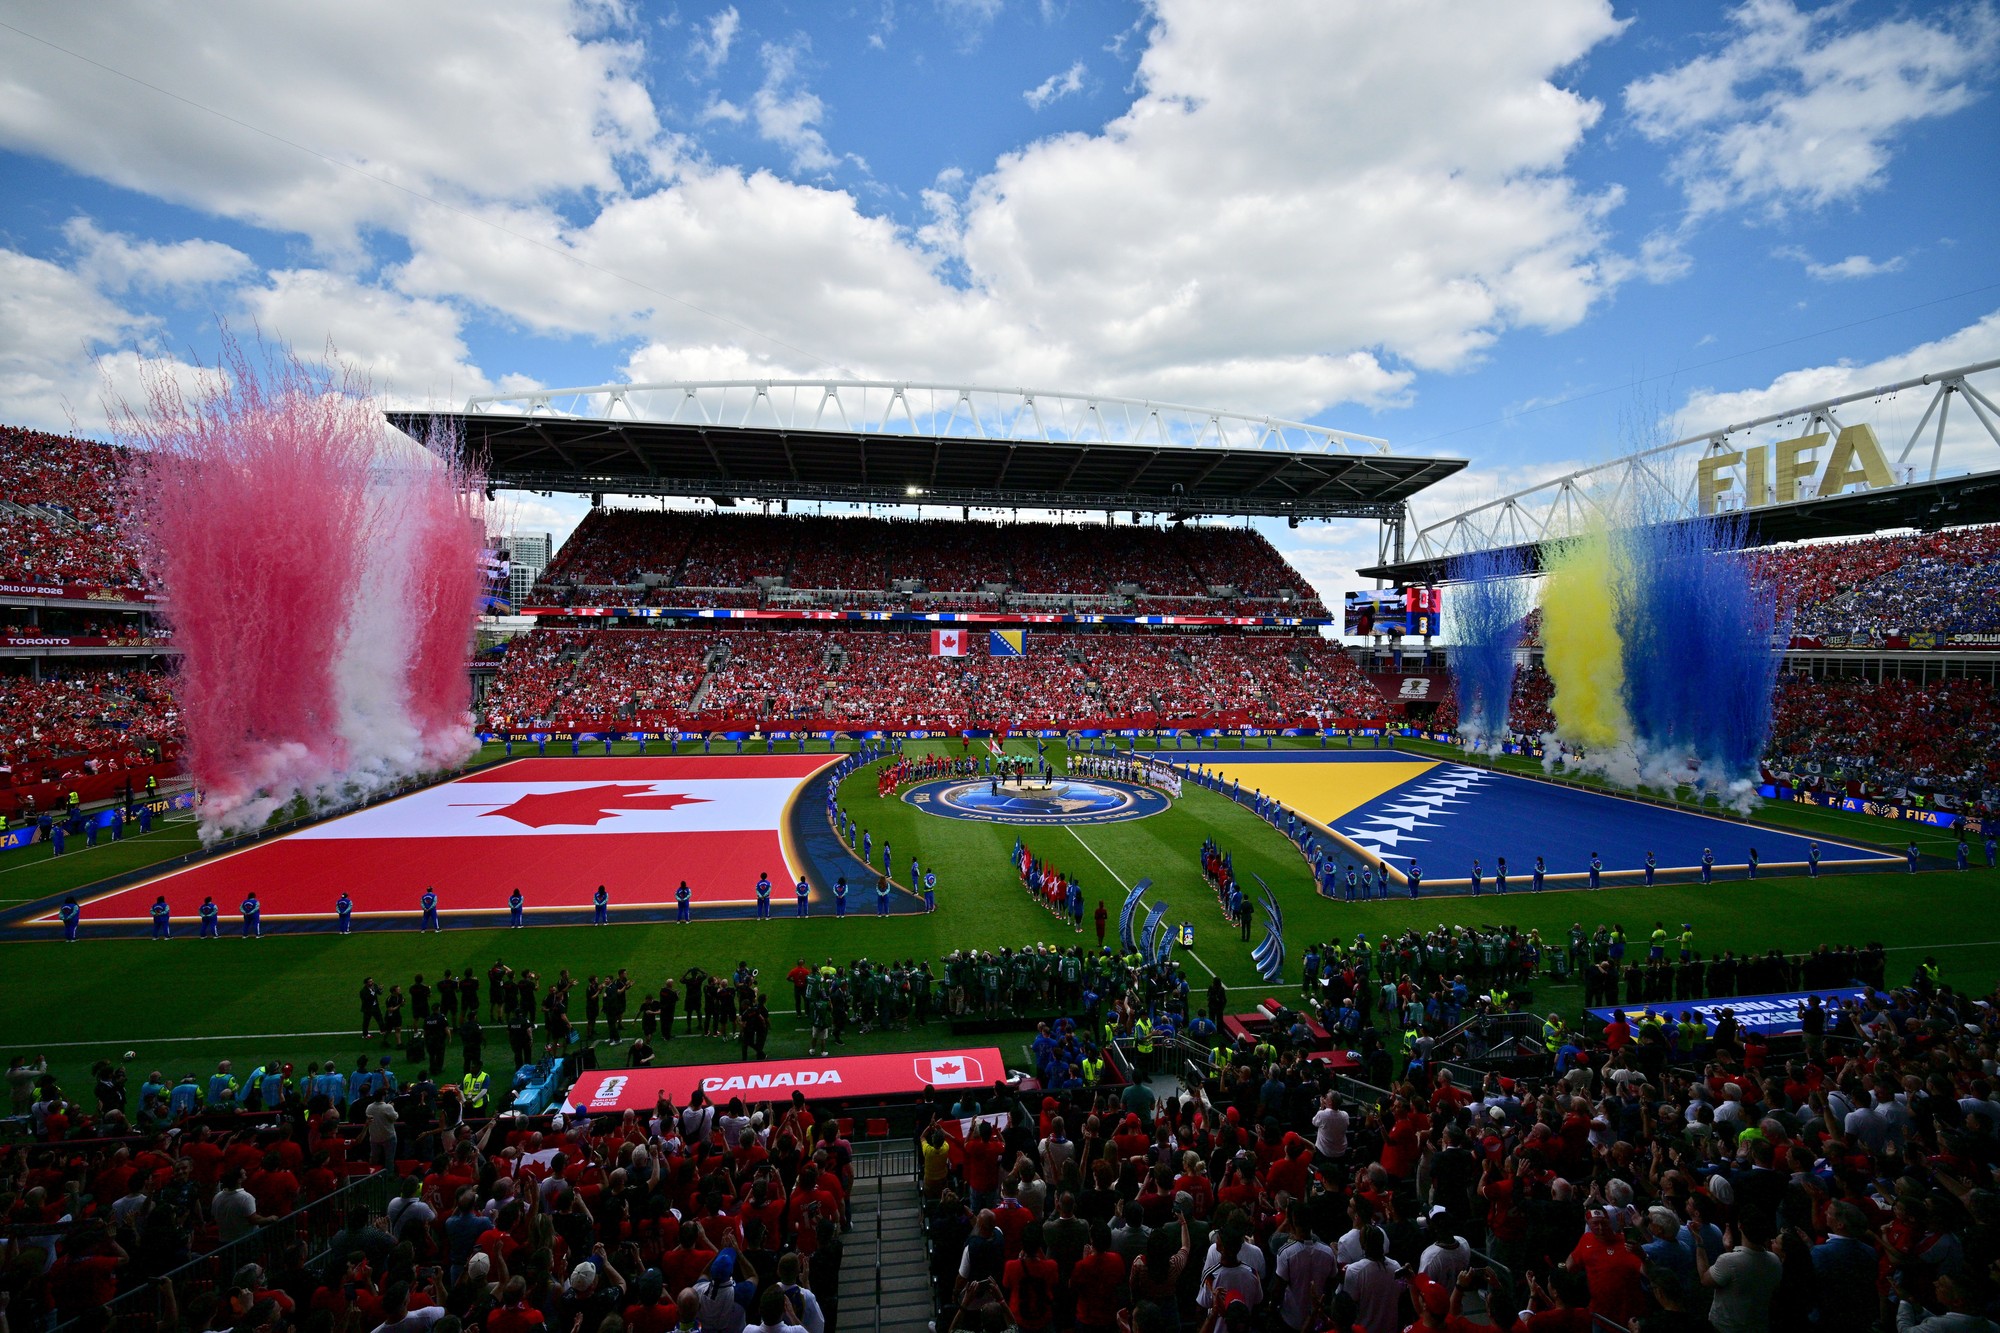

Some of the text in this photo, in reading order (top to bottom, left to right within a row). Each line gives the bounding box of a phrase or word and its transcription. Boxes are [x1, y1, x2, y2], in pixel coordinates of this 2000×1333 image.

[1698, 423, 1898, 516] FIFA
[37, 587, 64, 595] 2026
[556, 733, 572, 741] FIFA
[1906, 809, 1938, 824] FIFA
[0, 833, 18, 847] FA
[703, 1070, 842, 1092] CANADA
